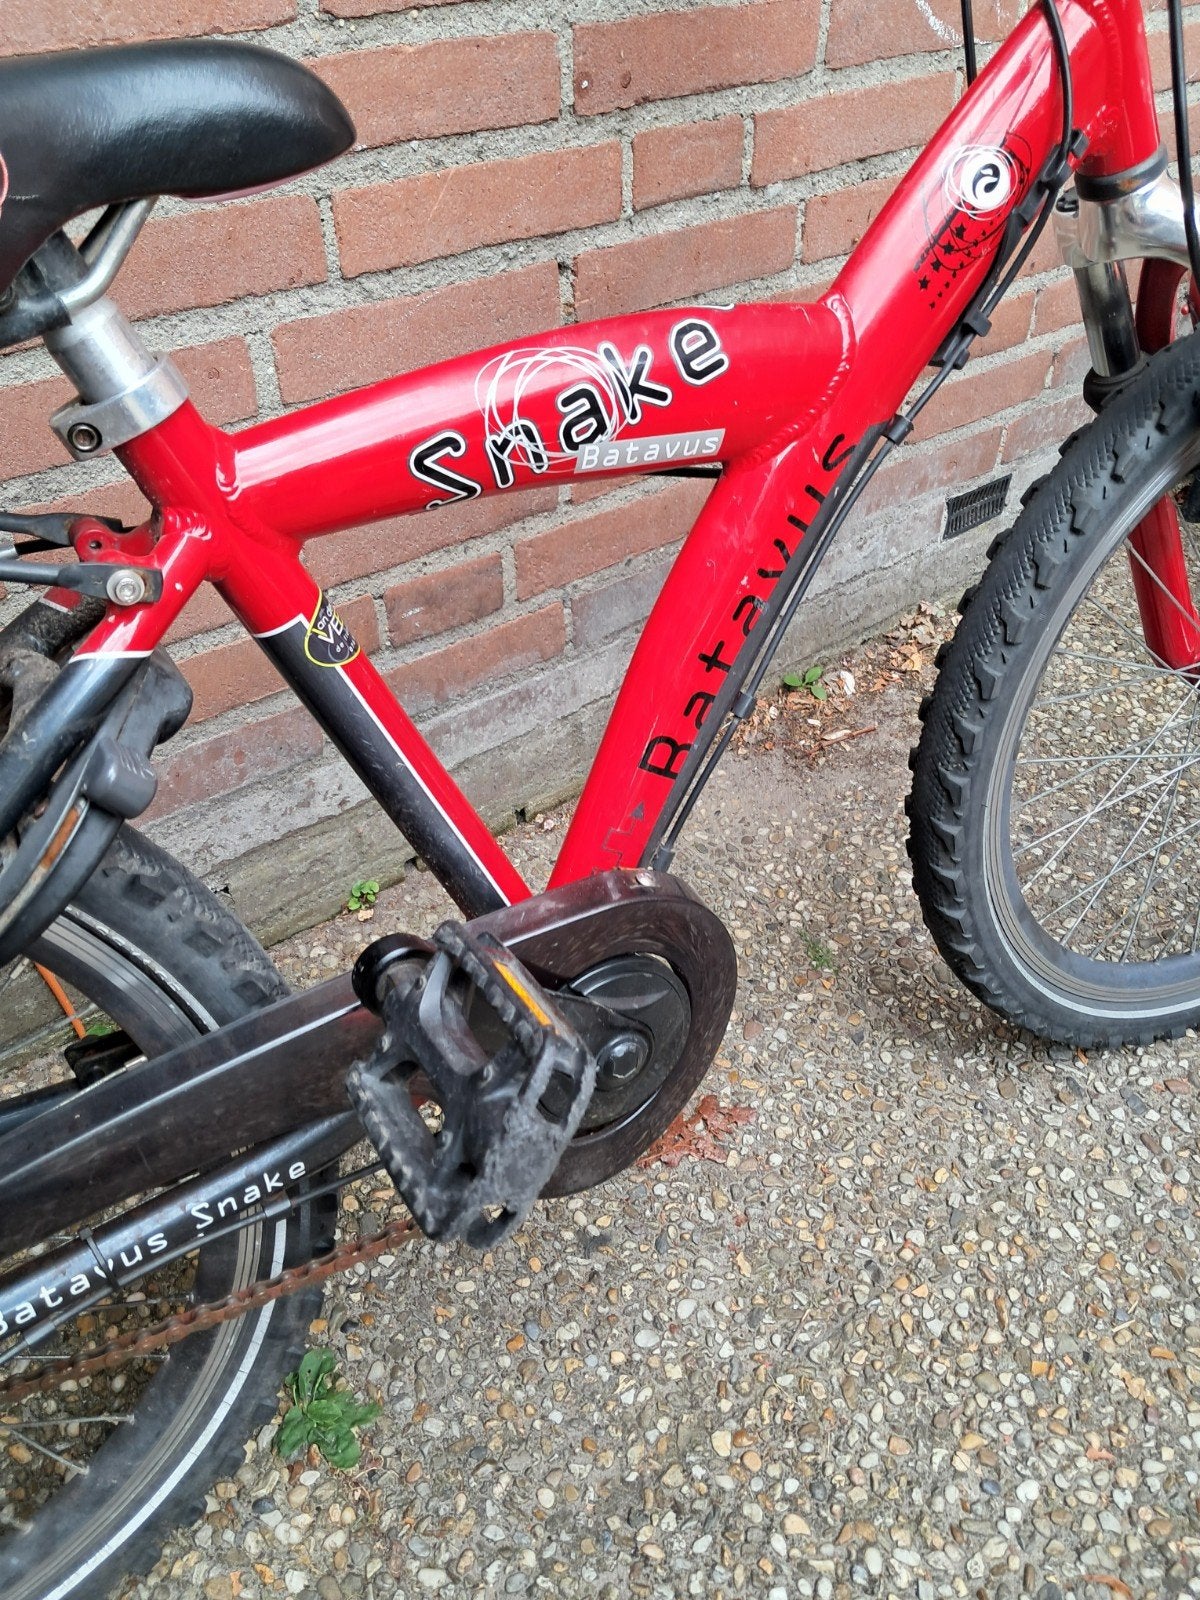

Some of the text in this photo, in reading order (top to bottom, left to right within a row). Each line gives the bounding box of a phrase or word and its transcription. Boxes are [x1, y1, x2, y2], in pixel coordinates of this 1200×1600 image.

[408, 317, 730, 511] Snake
[579, 434, 720, 471] Batavus
[190, 1160, 306, 1237] Snake
